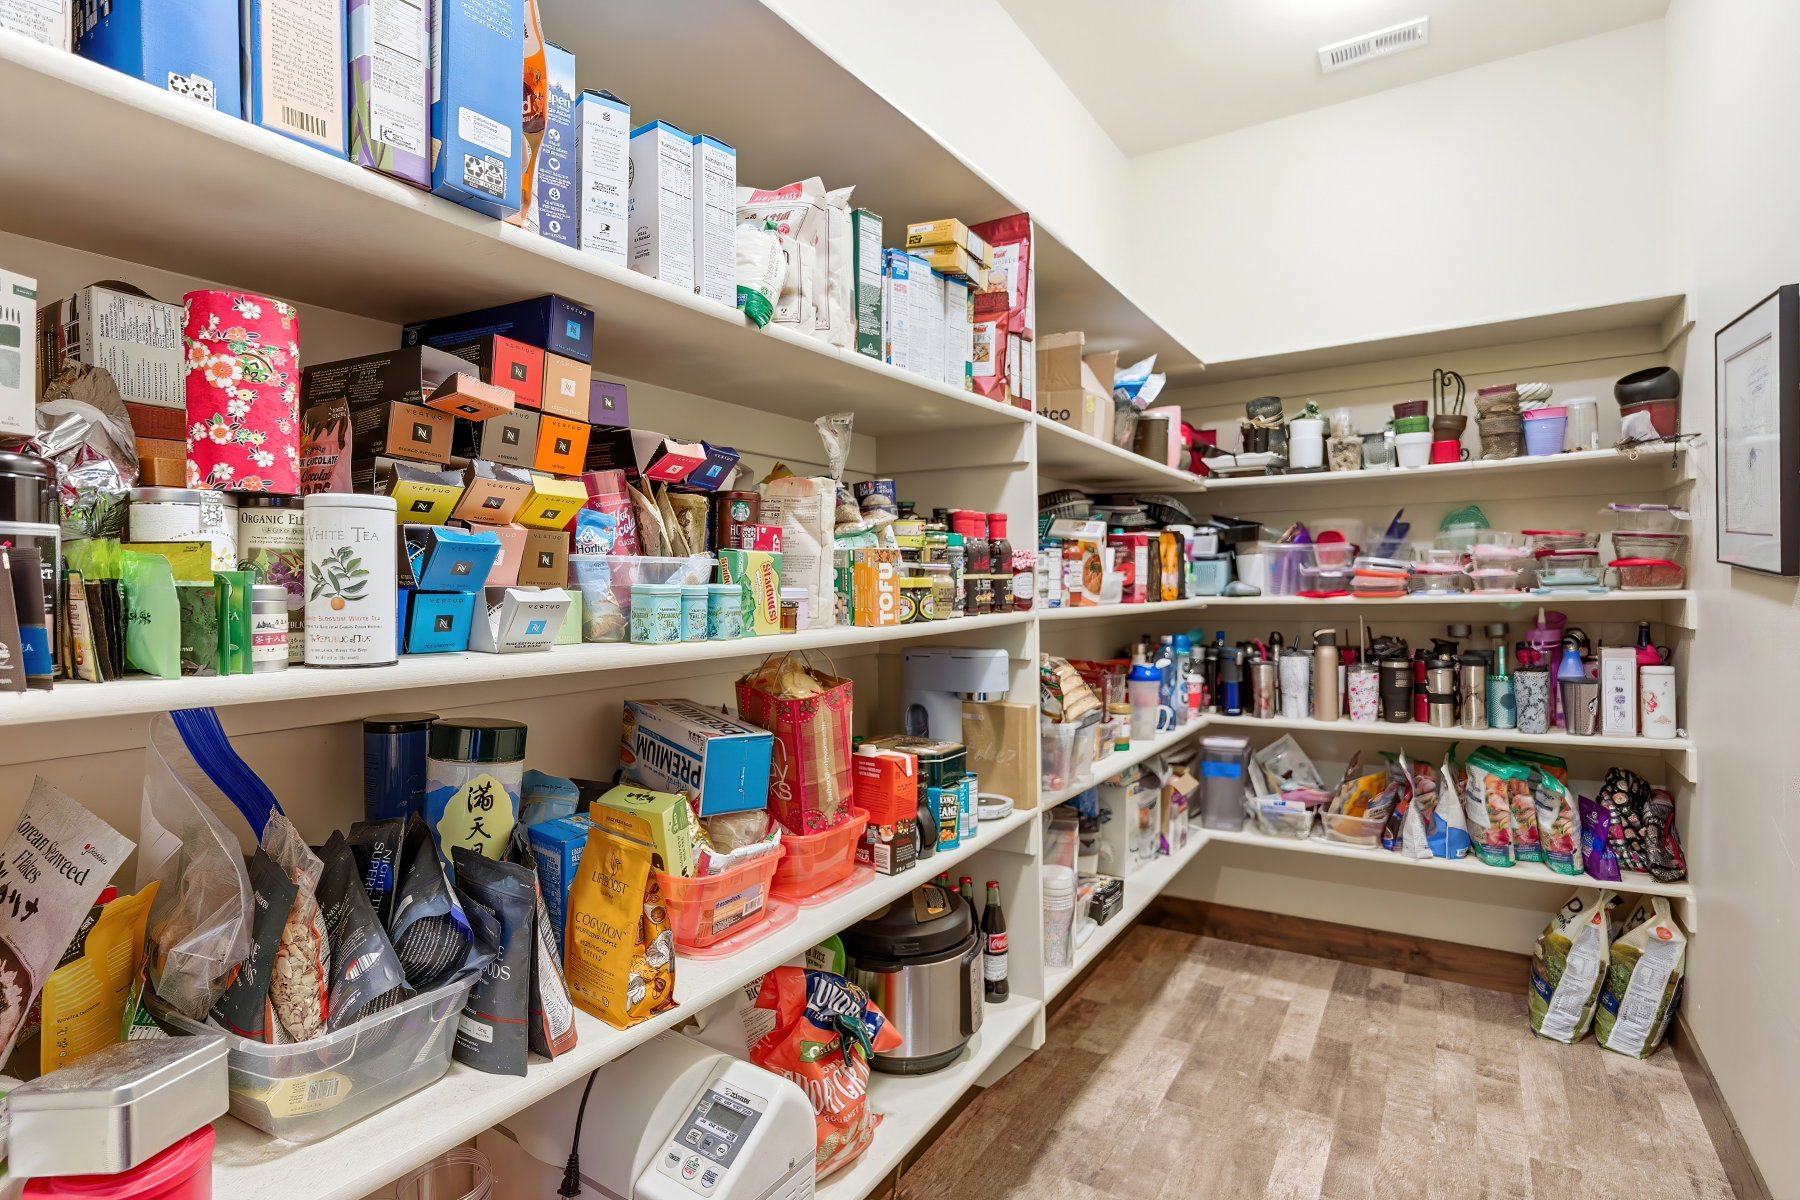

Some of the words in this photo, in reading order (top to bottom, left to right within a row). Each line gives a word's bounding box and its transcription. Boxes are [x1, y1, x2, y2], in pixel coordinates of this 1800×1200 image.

[549, 91, 571, 108] lpen
[241, 511, 284, 526] ORGANIC
[351, 527, 379, 542] TEA
[879, 563, 894, 625] TOFU
[636, 733, 702, 790] PREMIUM
[12, 849, 42, 884] Flakes
[42, 840, 91, 887] Seaweed
